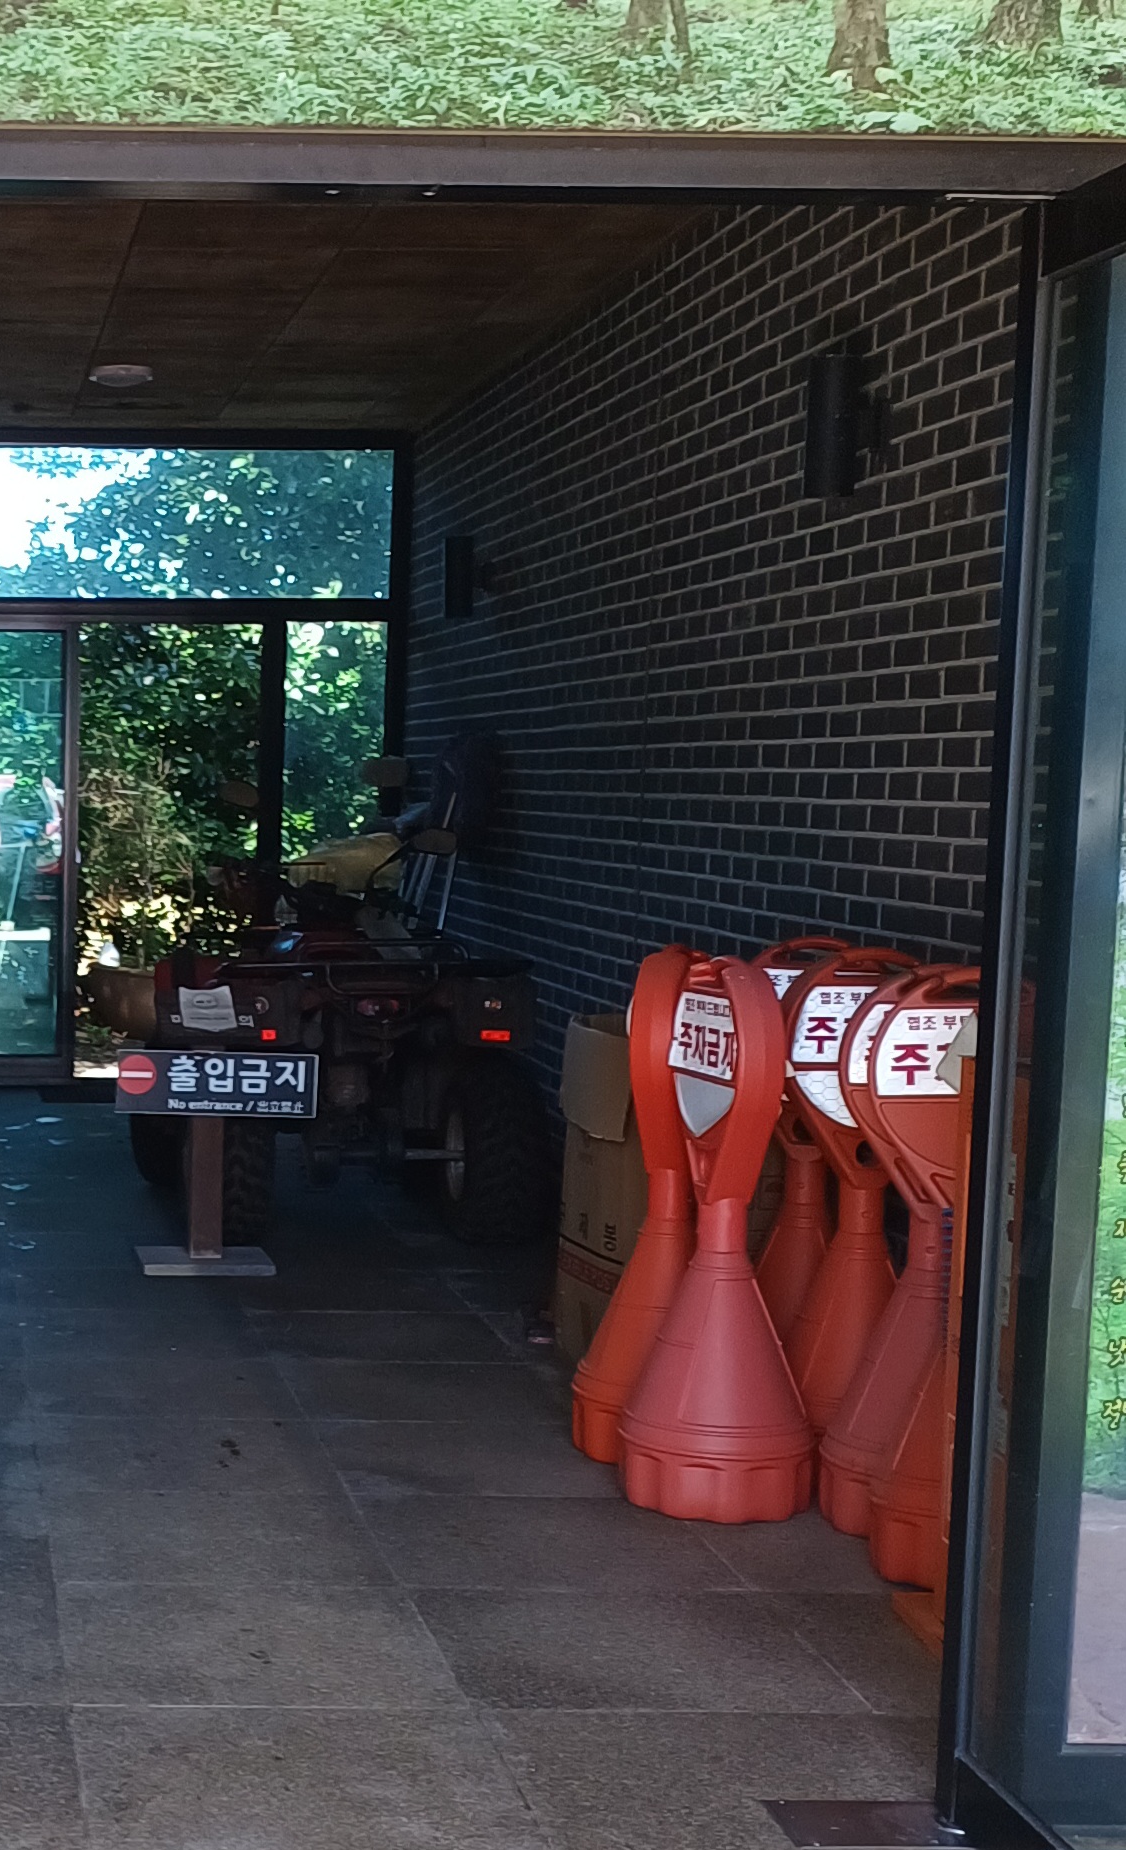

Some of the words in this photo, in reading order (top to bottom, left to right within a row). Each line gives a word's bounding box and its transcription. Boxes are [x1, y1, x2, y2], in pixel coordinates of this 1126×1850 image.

[819, 991, 845, 1005] 협조
[907, 1015, 937, 1031] 협조
[166, 1054, 307, 1094] 출입금지
[167, 1098, 187, 1110] No
